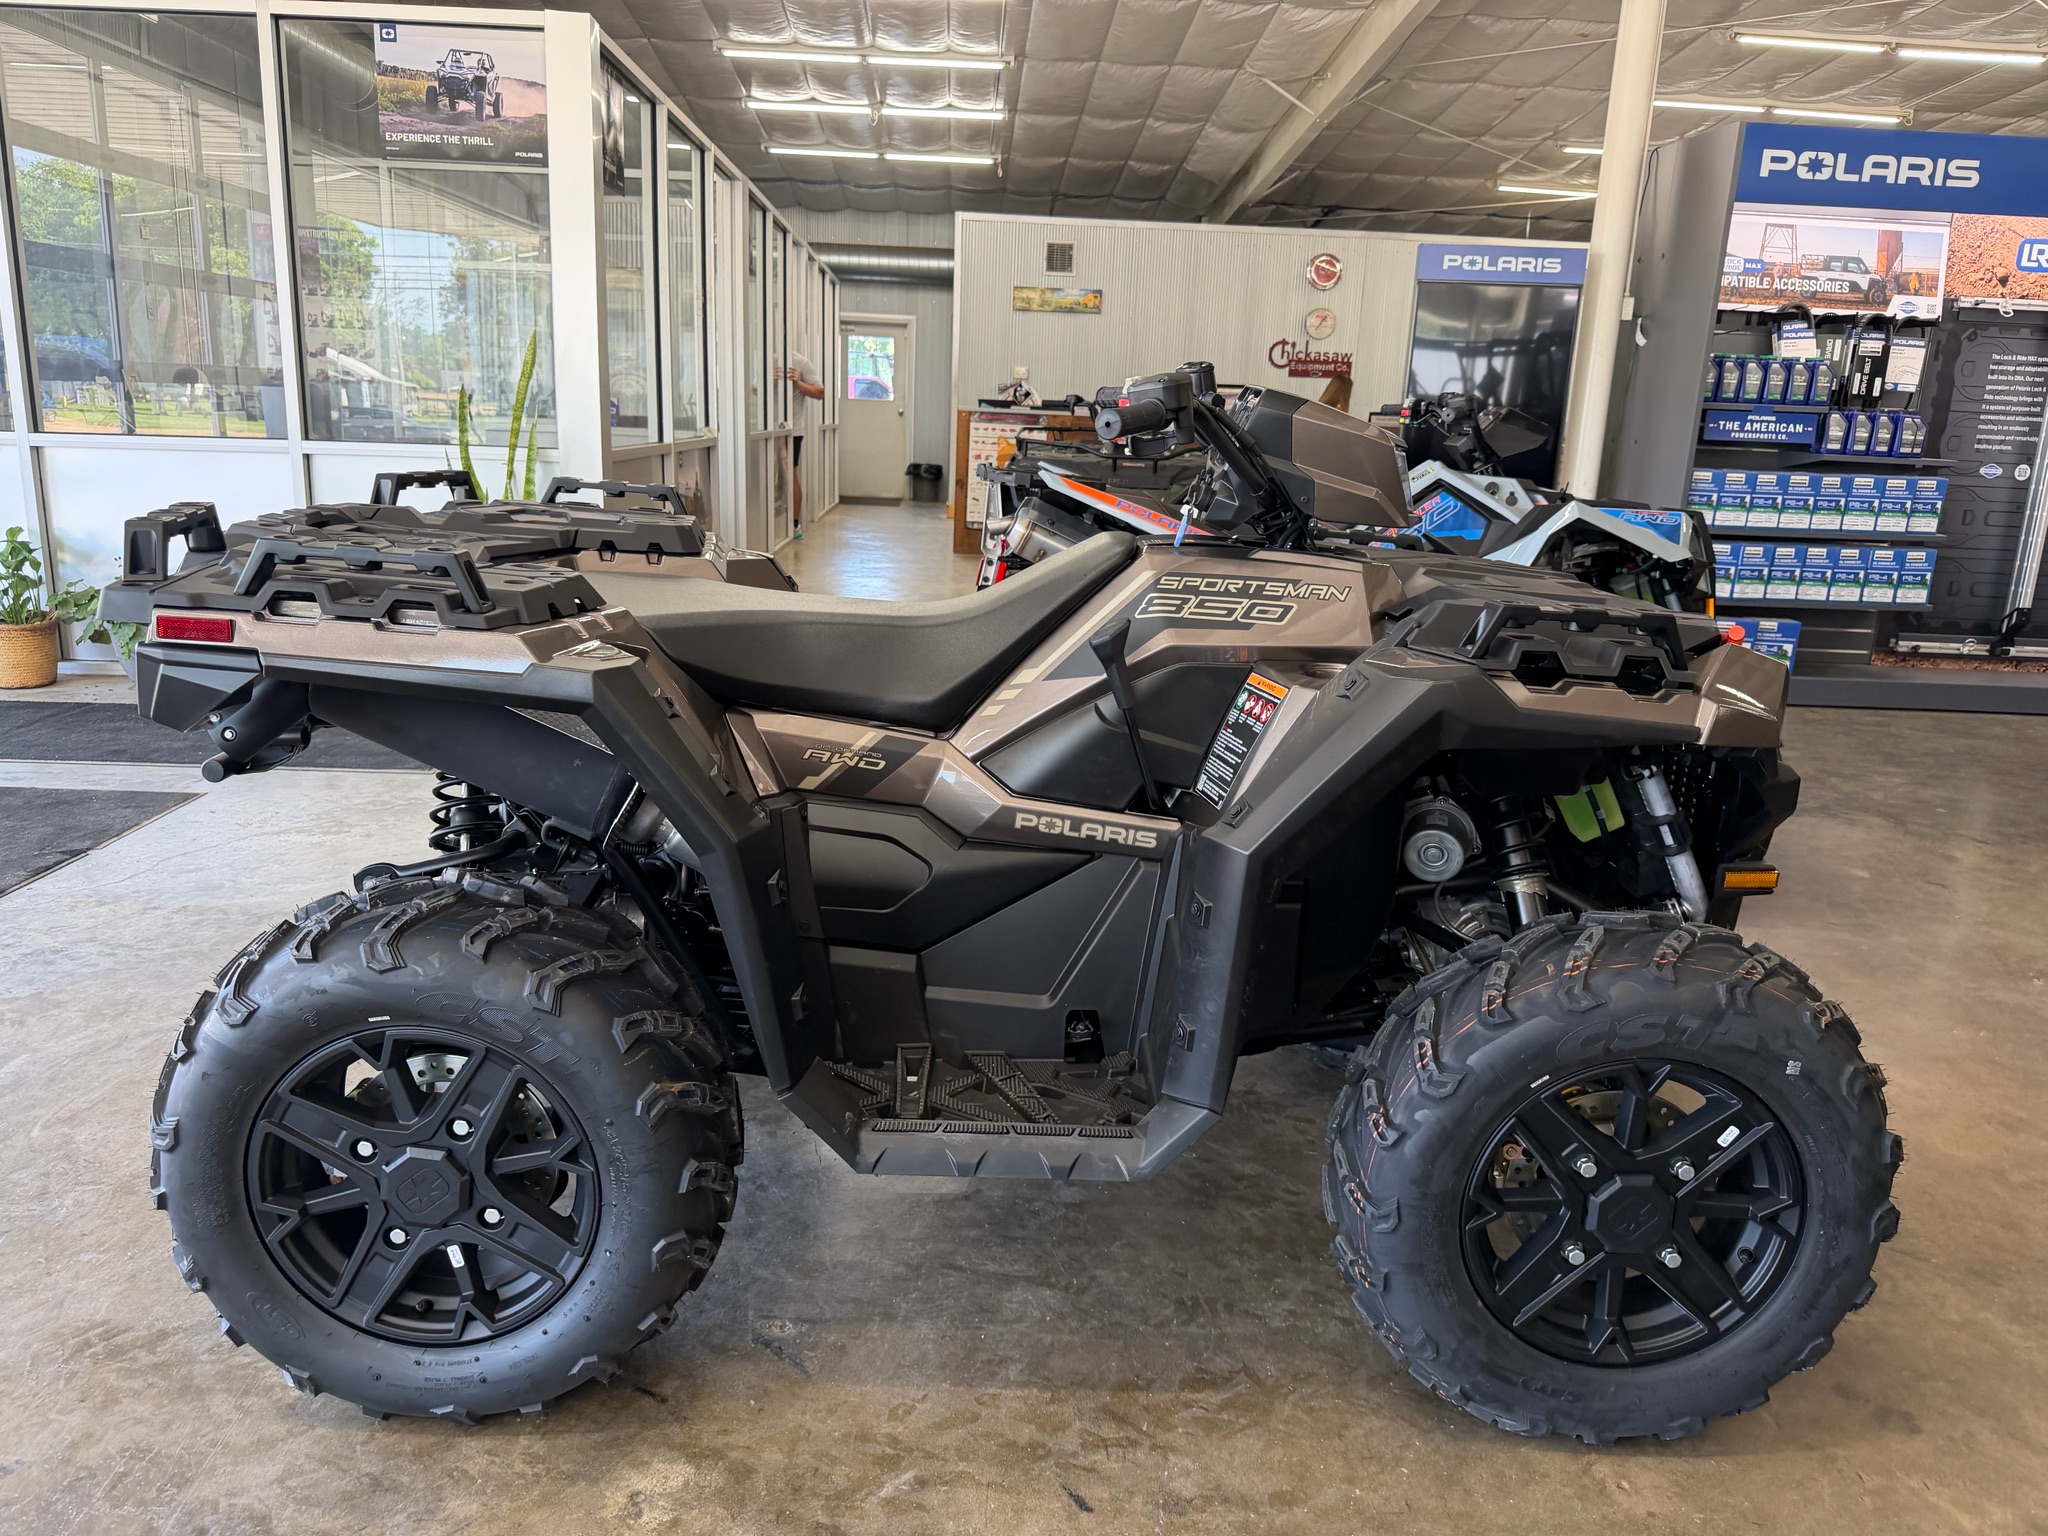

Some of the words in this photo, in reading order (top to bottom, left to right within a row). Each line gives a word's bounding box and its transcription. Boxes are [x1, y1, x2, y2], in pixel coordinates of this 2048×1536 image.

[385, 132, 441, 144] EXPERIENCE
[443, 135, 461, 144] THE
[462, 136, 494, 146] THRILL
[1759, 148, 1981, 189] POLARIS
[1442, 254, 1562, 274] POLARIS
[1721, 275, 1770, 289] PATIBLE
[1772, 277, 1850, 293] ACCESSORIES
[1268, 338, 1353, 369] Chickasaw
[1290, 363, 1335, 372] Equipment
[1335, 364, 1350, 372] Co.
[1864, 357, 1872, 374] BELT
[1860, 375, 1869, 395] DRIVE
[1719, 421, 1741, 431] THE
[1744, 422, 1803, 433] AMERICAN
[1617, 512, 1681, 526] AWD
[1157, 575, 1353, 602] SPORTSMAN
[1134, 592, 1298, 626] 850
[802, 748, 887, 771] AWD
[835, 747, 882, 758] DEMAND
[1015, 811, 1158, 849] POLARIS
[416, 991, 581, 1065] CST
[1556, 1013, 1730, 1065] CST
